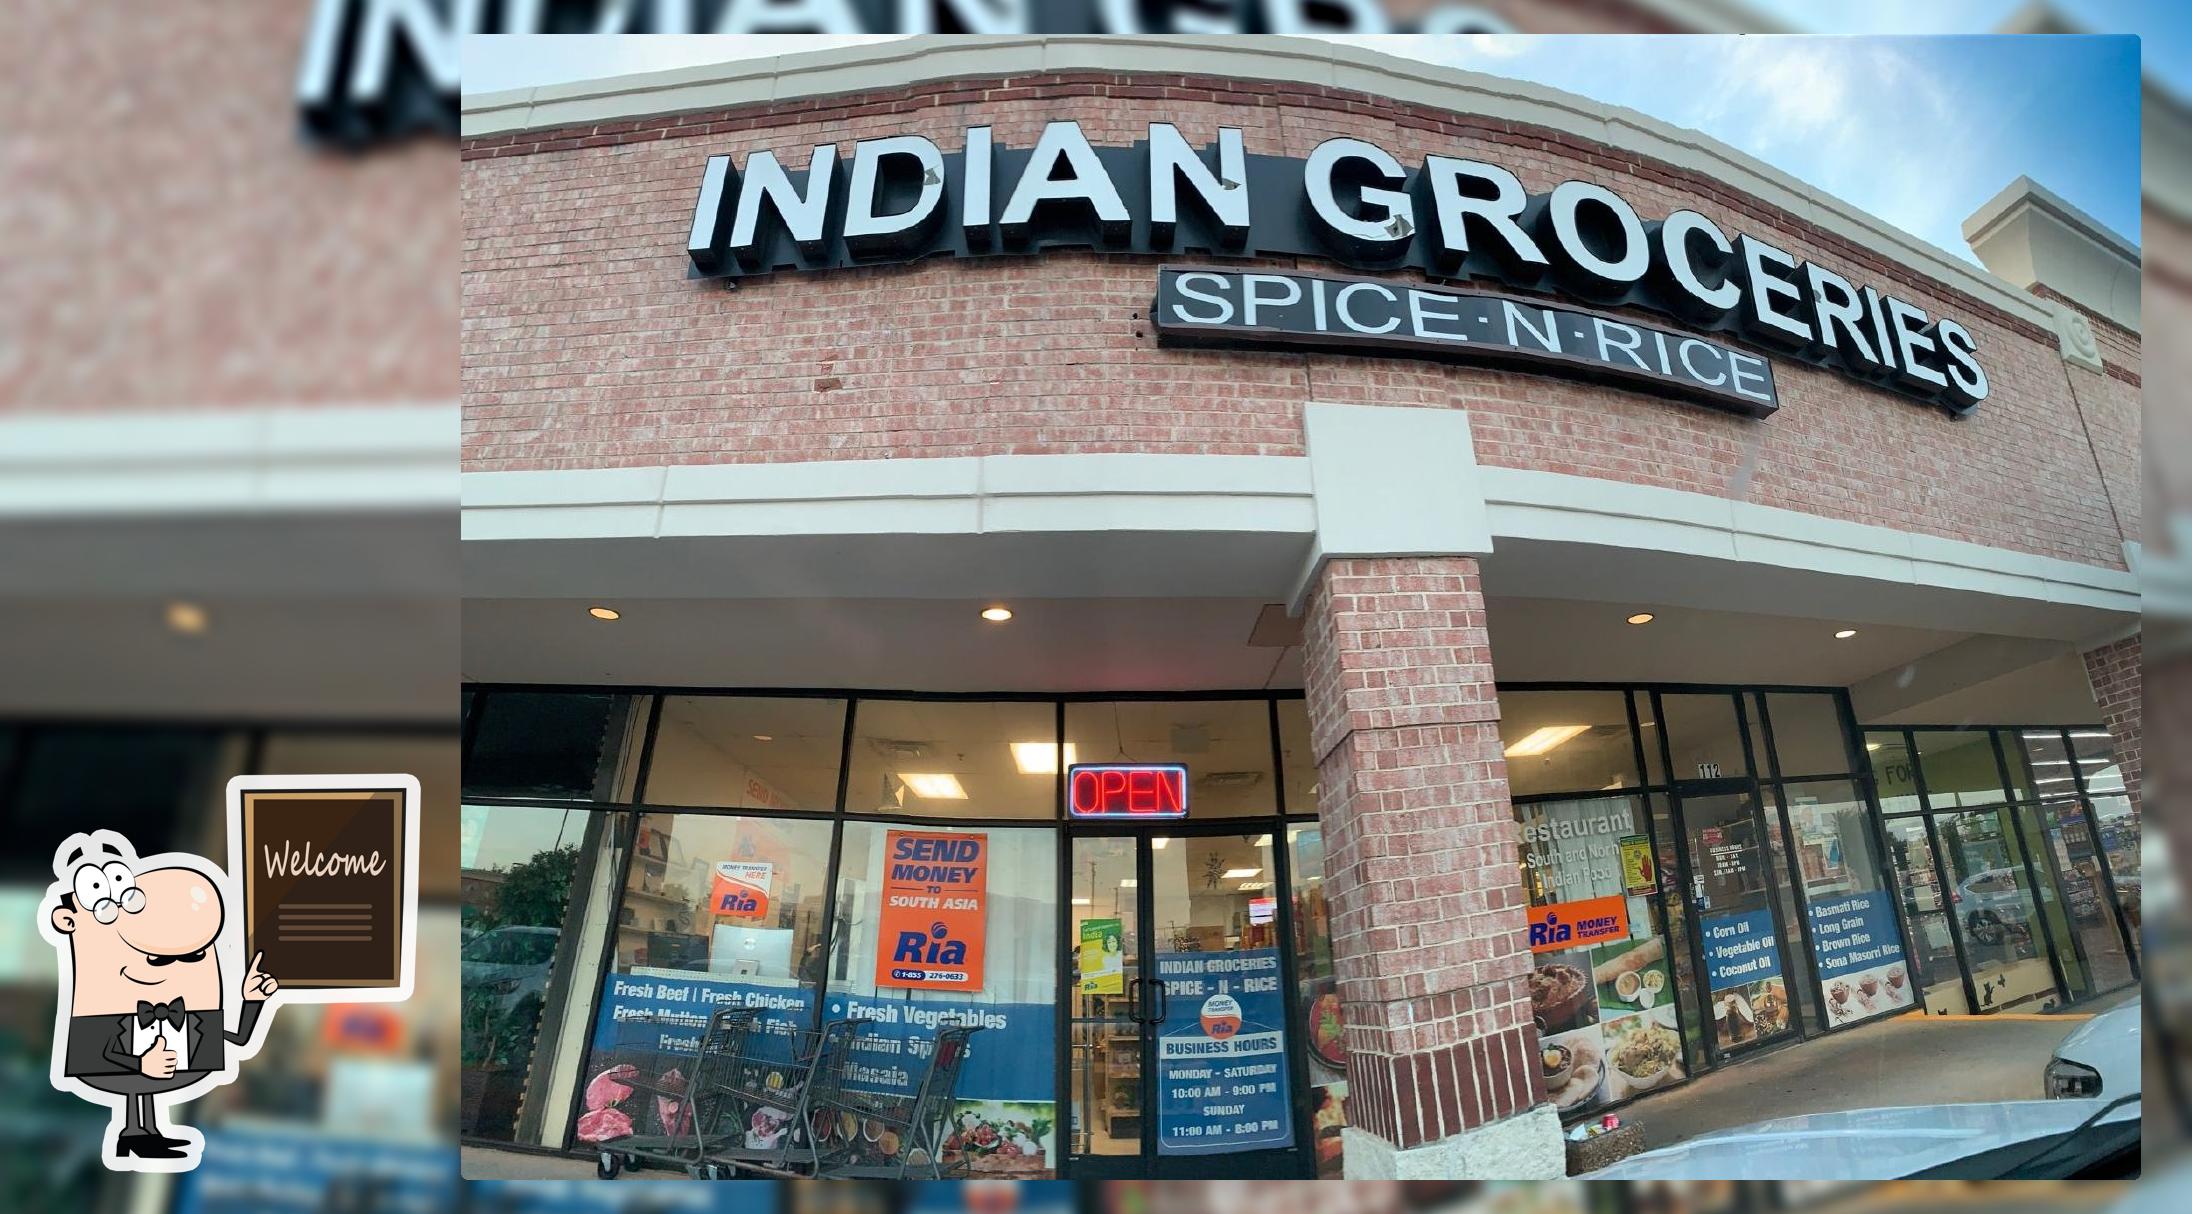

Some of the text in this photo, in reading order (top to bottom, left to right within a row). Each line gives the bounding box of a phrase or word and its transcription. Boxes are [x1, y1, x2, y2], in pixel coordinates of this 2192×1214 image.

[688, 120, 1990, 402] INDIAN GROCERIES
[1699, 764, 1721, 778] 112
[1073, 770, 1182, 814] OPEN
[893, 838, 980, 863] SEND
[1527, 850, 1562, 869] South
[1566, 847, 1586, 864] and
[745, 871, 767, 880] HERE
[891, 864, 978, 884] MONEY
[926, 886, 941, 894] TO
[720, 890, 757, 911] Ria
[889, 896, 978, 911] SOUTH ASIA
[1815, 898, 1870, 917] Basmati Rice
[1529, 911, 1572, 947] Ria
[1576, 916, 1618, 930] MONEY
[1577, 925, 1620, 939] TRANSFER
[1713, 921, 1750, 938] Corn Oil
[1818, 916, 1864, 938] Long Grain
[893, 921, 967, 966] Ria
[1715, 935, 1774, 959] Vegetable Oil
[1822, 932, 1871, 952] Brown Rice
[1160, 956, 1277, 974] INDIAN GROCERIES
[1825, 955, 1849, 970] Sona
[1882, 942, 1900, 958] Rice
[1719, 955, 1771, 978] Coconut Oil
[1163, 980, 1203, 995] SPICE
[1218, 979, 1228, 994] N
[1244, 976, 1278, 993] RICE
[614, 981, 653, 998] Fresh
[656, 984, 689, 1001] Beef
[701, 988, 742, 1006] Fresh
[745, 992, 805, 1011] Chicken
[847, 1001, 1007, 1030] Fresh Vegetables
[1166, 1037, 1277, 1055] BUSINESS HOURS
[1169, 1069, 1212, 1080] MONDAY
[1224, 1064, 1277, 1078] SATURDAY
[1172, 1088, 1201, 1099] 10:00
[1204, 1086, 1221, 1097] AM
[1232, 1084, 1256, 1096] 9:00
[1259, 1082, 1276, 1093] PM
[1203, 1104, 1245, 1116] SUNDAY
[1172, 1127, 1203, 1137] 11:00
[1206, 1125, 1222, 1135] AM
[1261, 1120, 1278, 1131] PM
